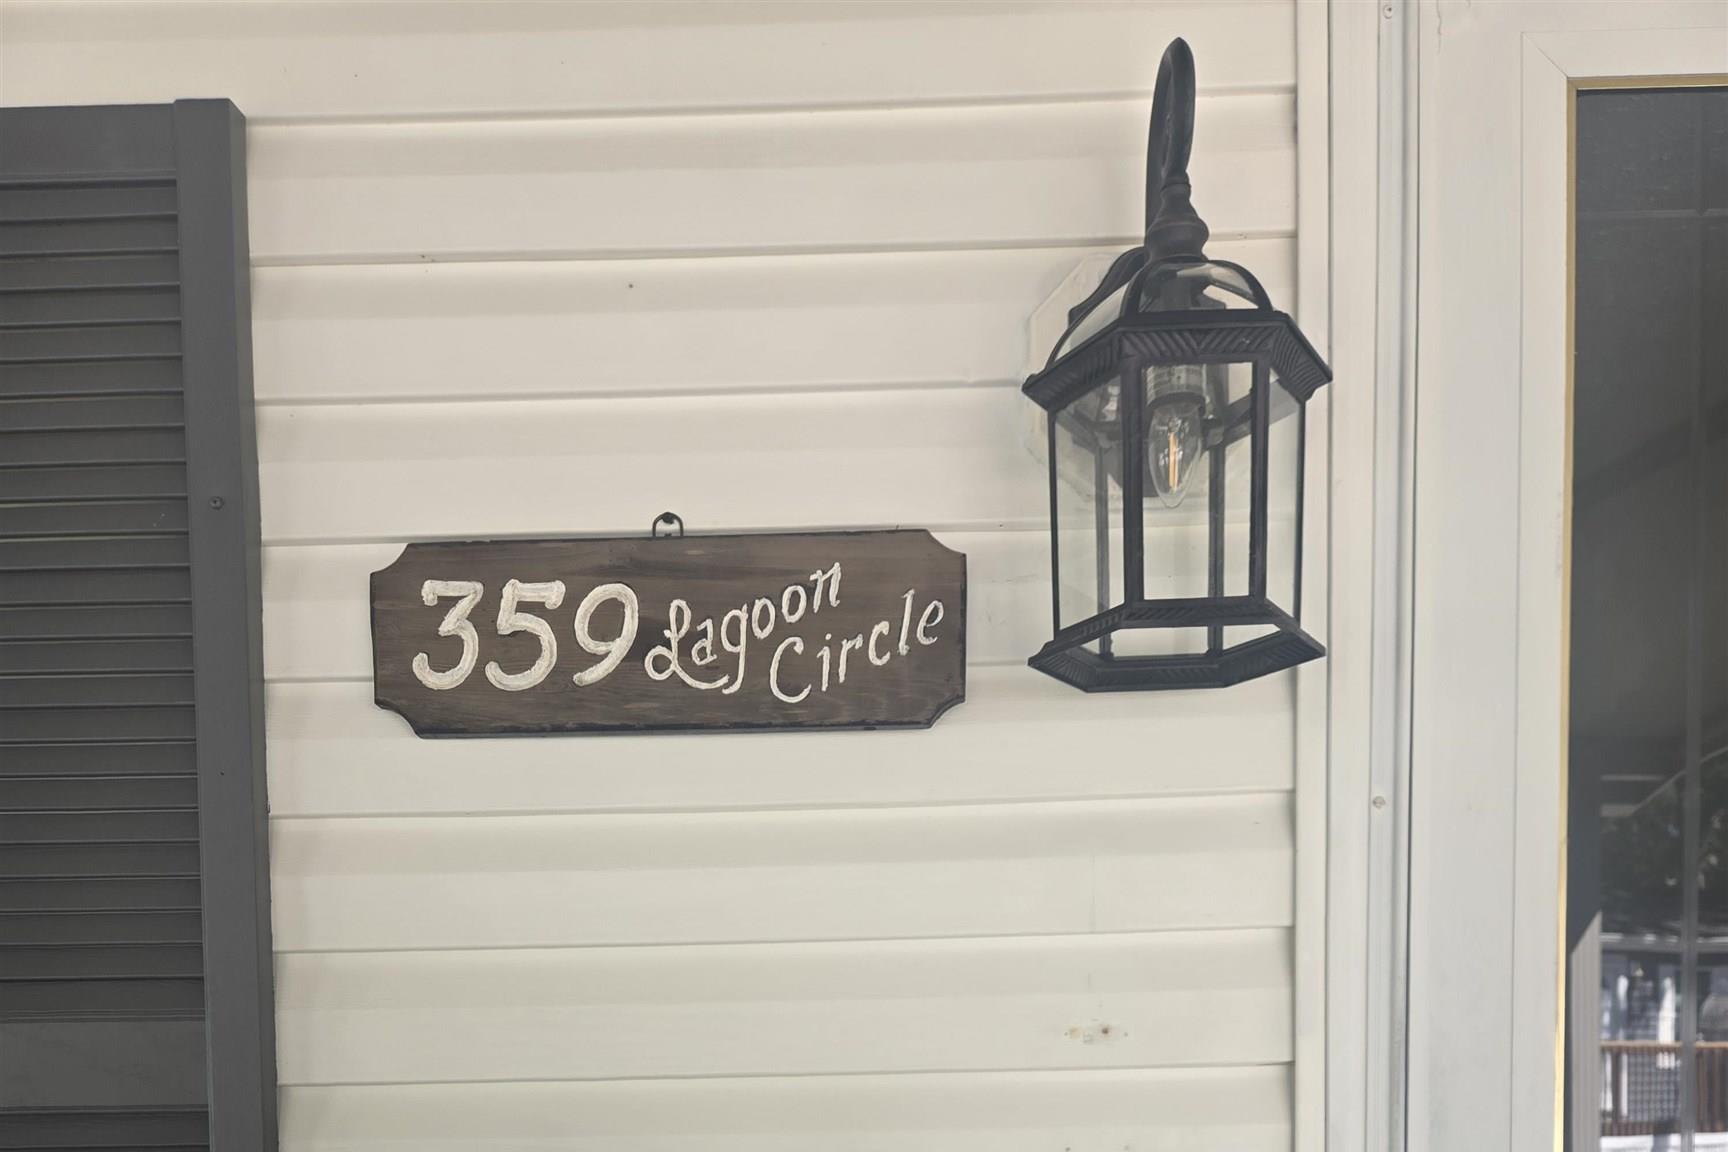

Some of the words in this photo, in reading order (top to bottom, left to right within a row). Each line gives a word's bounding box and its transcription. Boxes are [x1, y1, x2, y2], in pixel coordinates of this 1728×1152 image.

[412, 579, 639, 691] 359
[645, 561, 841, 694] Lagoon
[770, 589, 945, 703] Circle
